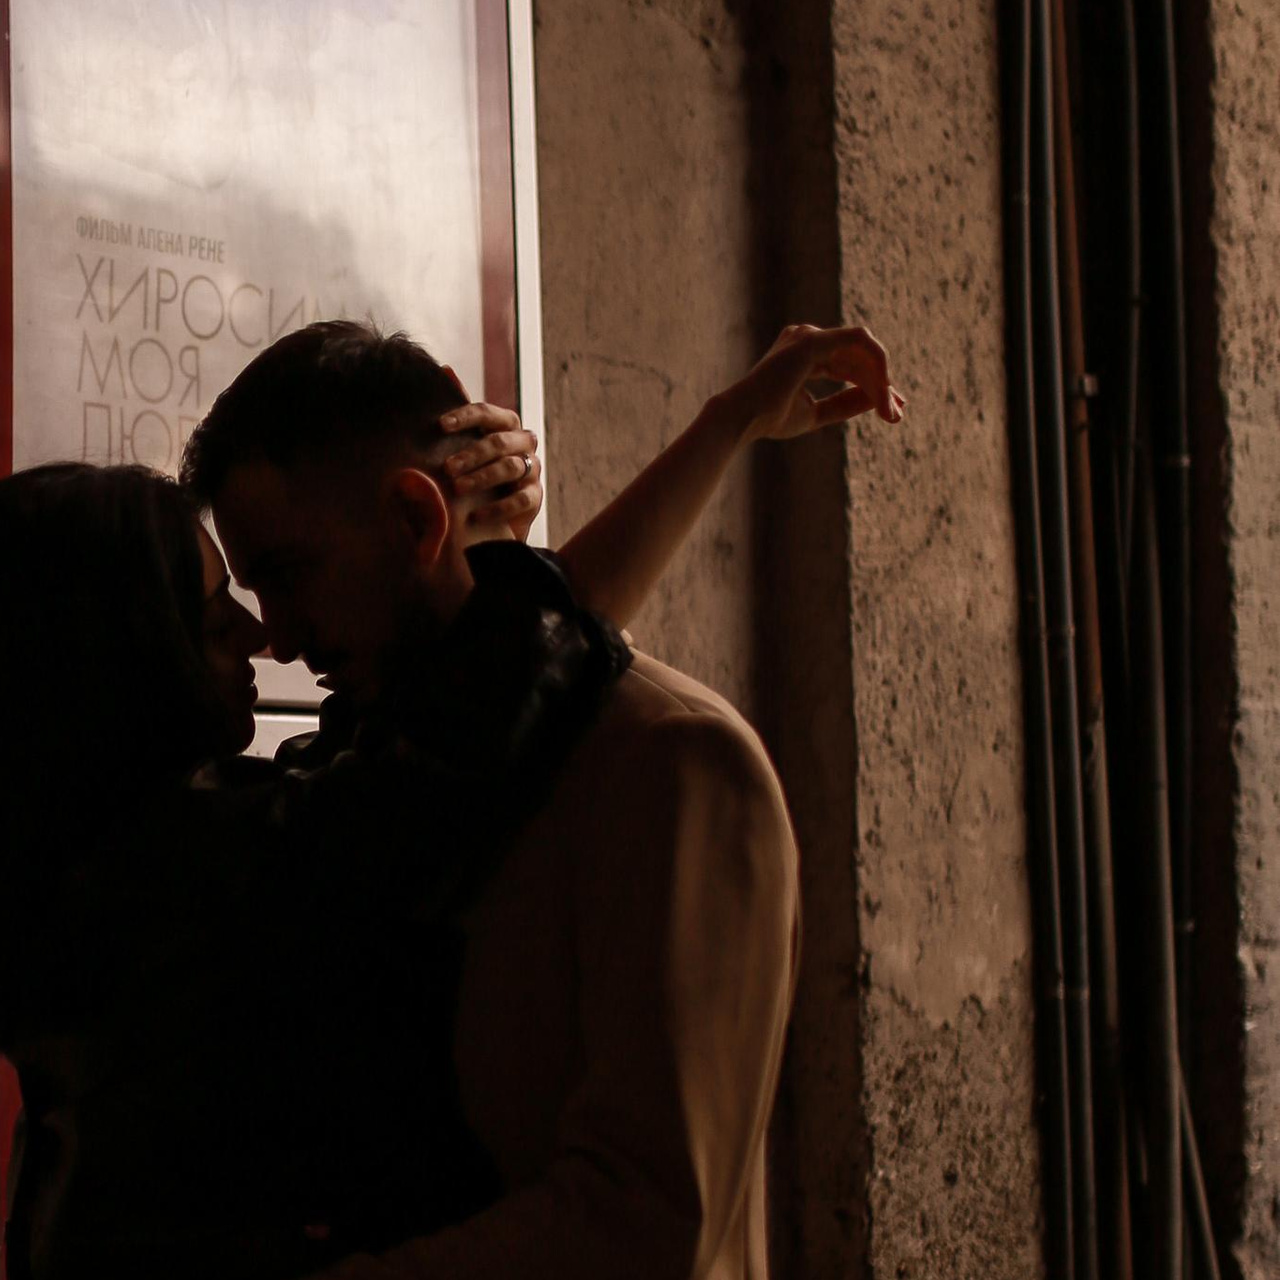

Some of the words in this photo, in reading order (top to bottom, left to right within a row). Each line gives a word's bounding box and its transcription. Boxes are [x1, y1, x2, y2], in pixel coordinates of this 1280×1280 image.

[188, 235, 225, 265] РЕНЕ
[75, 253, 360, 348] ХИРОСИ
[77, 330, 200, 410] МОЯ
